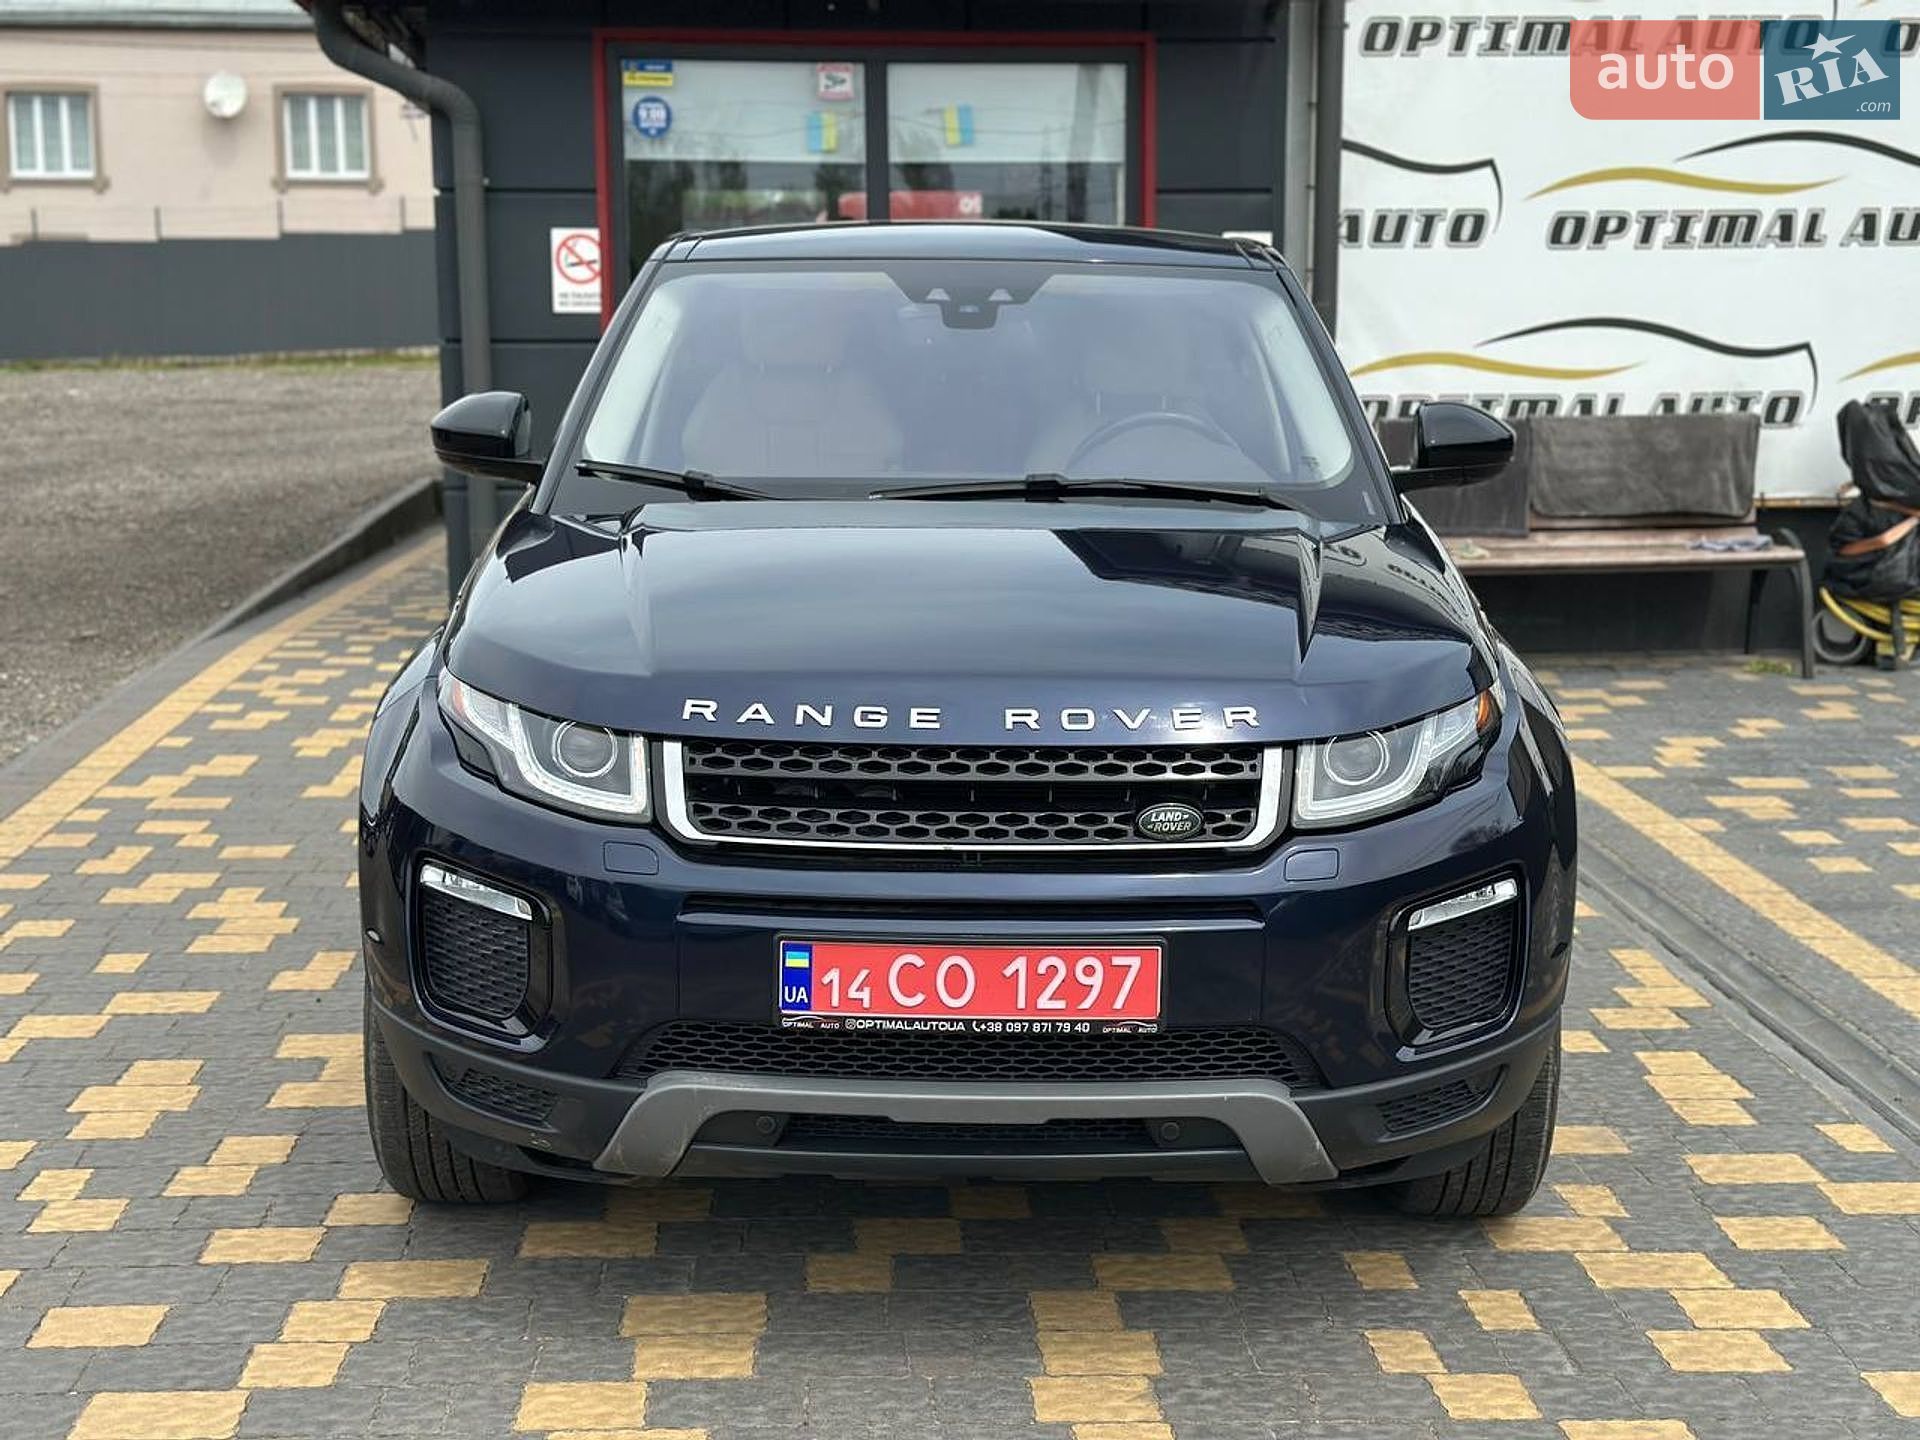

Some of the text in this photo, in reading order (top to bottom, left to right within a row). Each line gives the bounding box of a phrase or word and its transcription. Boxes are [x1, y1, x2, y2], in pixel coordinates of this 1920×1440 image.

[1359, 15, 1641, 57] OPTIMAL
[1546, 208, 1827, 250] OPTIMAL
[682, 698, 1260, 731] RANGE ROVER
[1151, 811, 1182, 822] LAND
[1153, 821, 1192, 832] ROVER
[784, 985, 809, 1004] UA
[821, 953, 1142, 1010] 14 CO 1297
